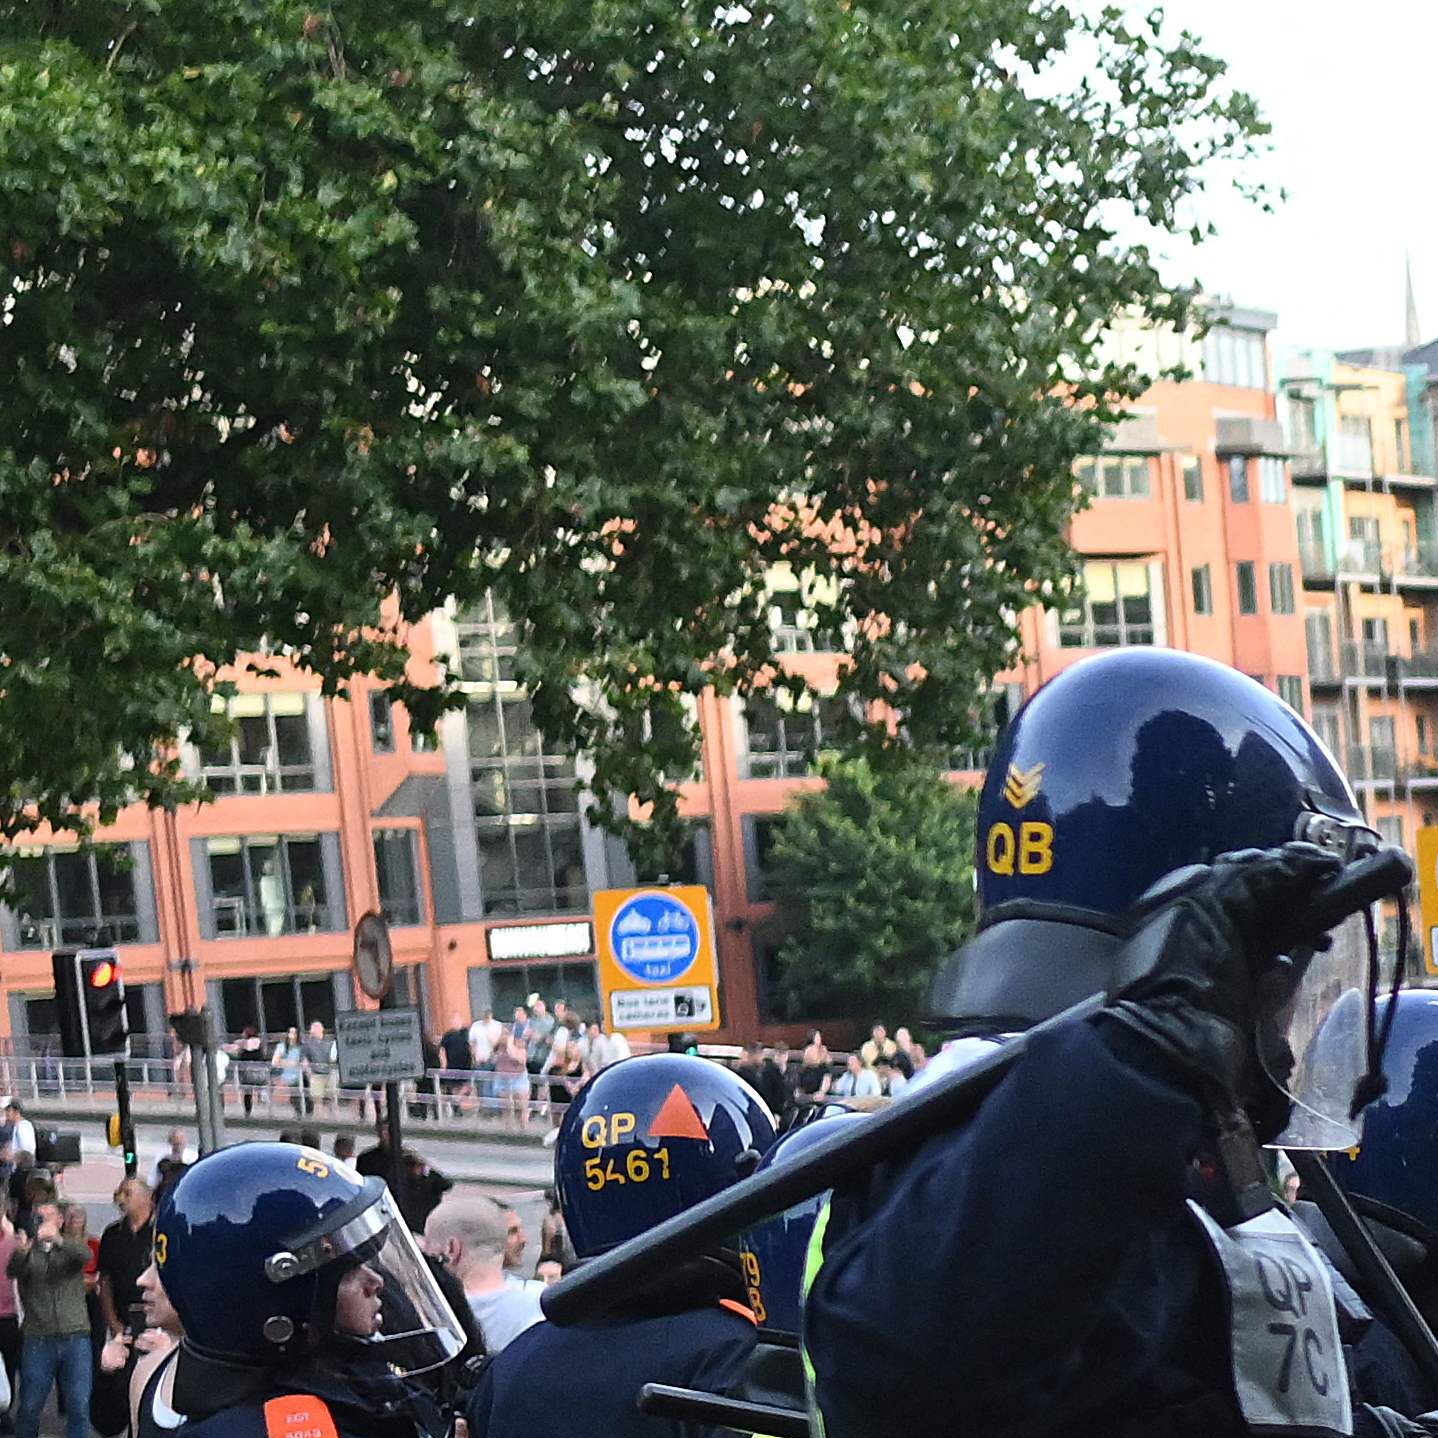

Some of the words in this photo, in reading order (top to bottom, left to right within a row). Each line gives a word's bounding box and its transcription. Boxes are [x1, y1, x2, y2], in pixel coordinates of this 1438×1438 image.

[986, 822, 1054, 876] QB
[643, 961, 672, 977] taxi
[581, 1112, 636, 1149] QP
[584, 1147, 670, 1191] 5461
[1255, 1249, 1312, 1319] QP
